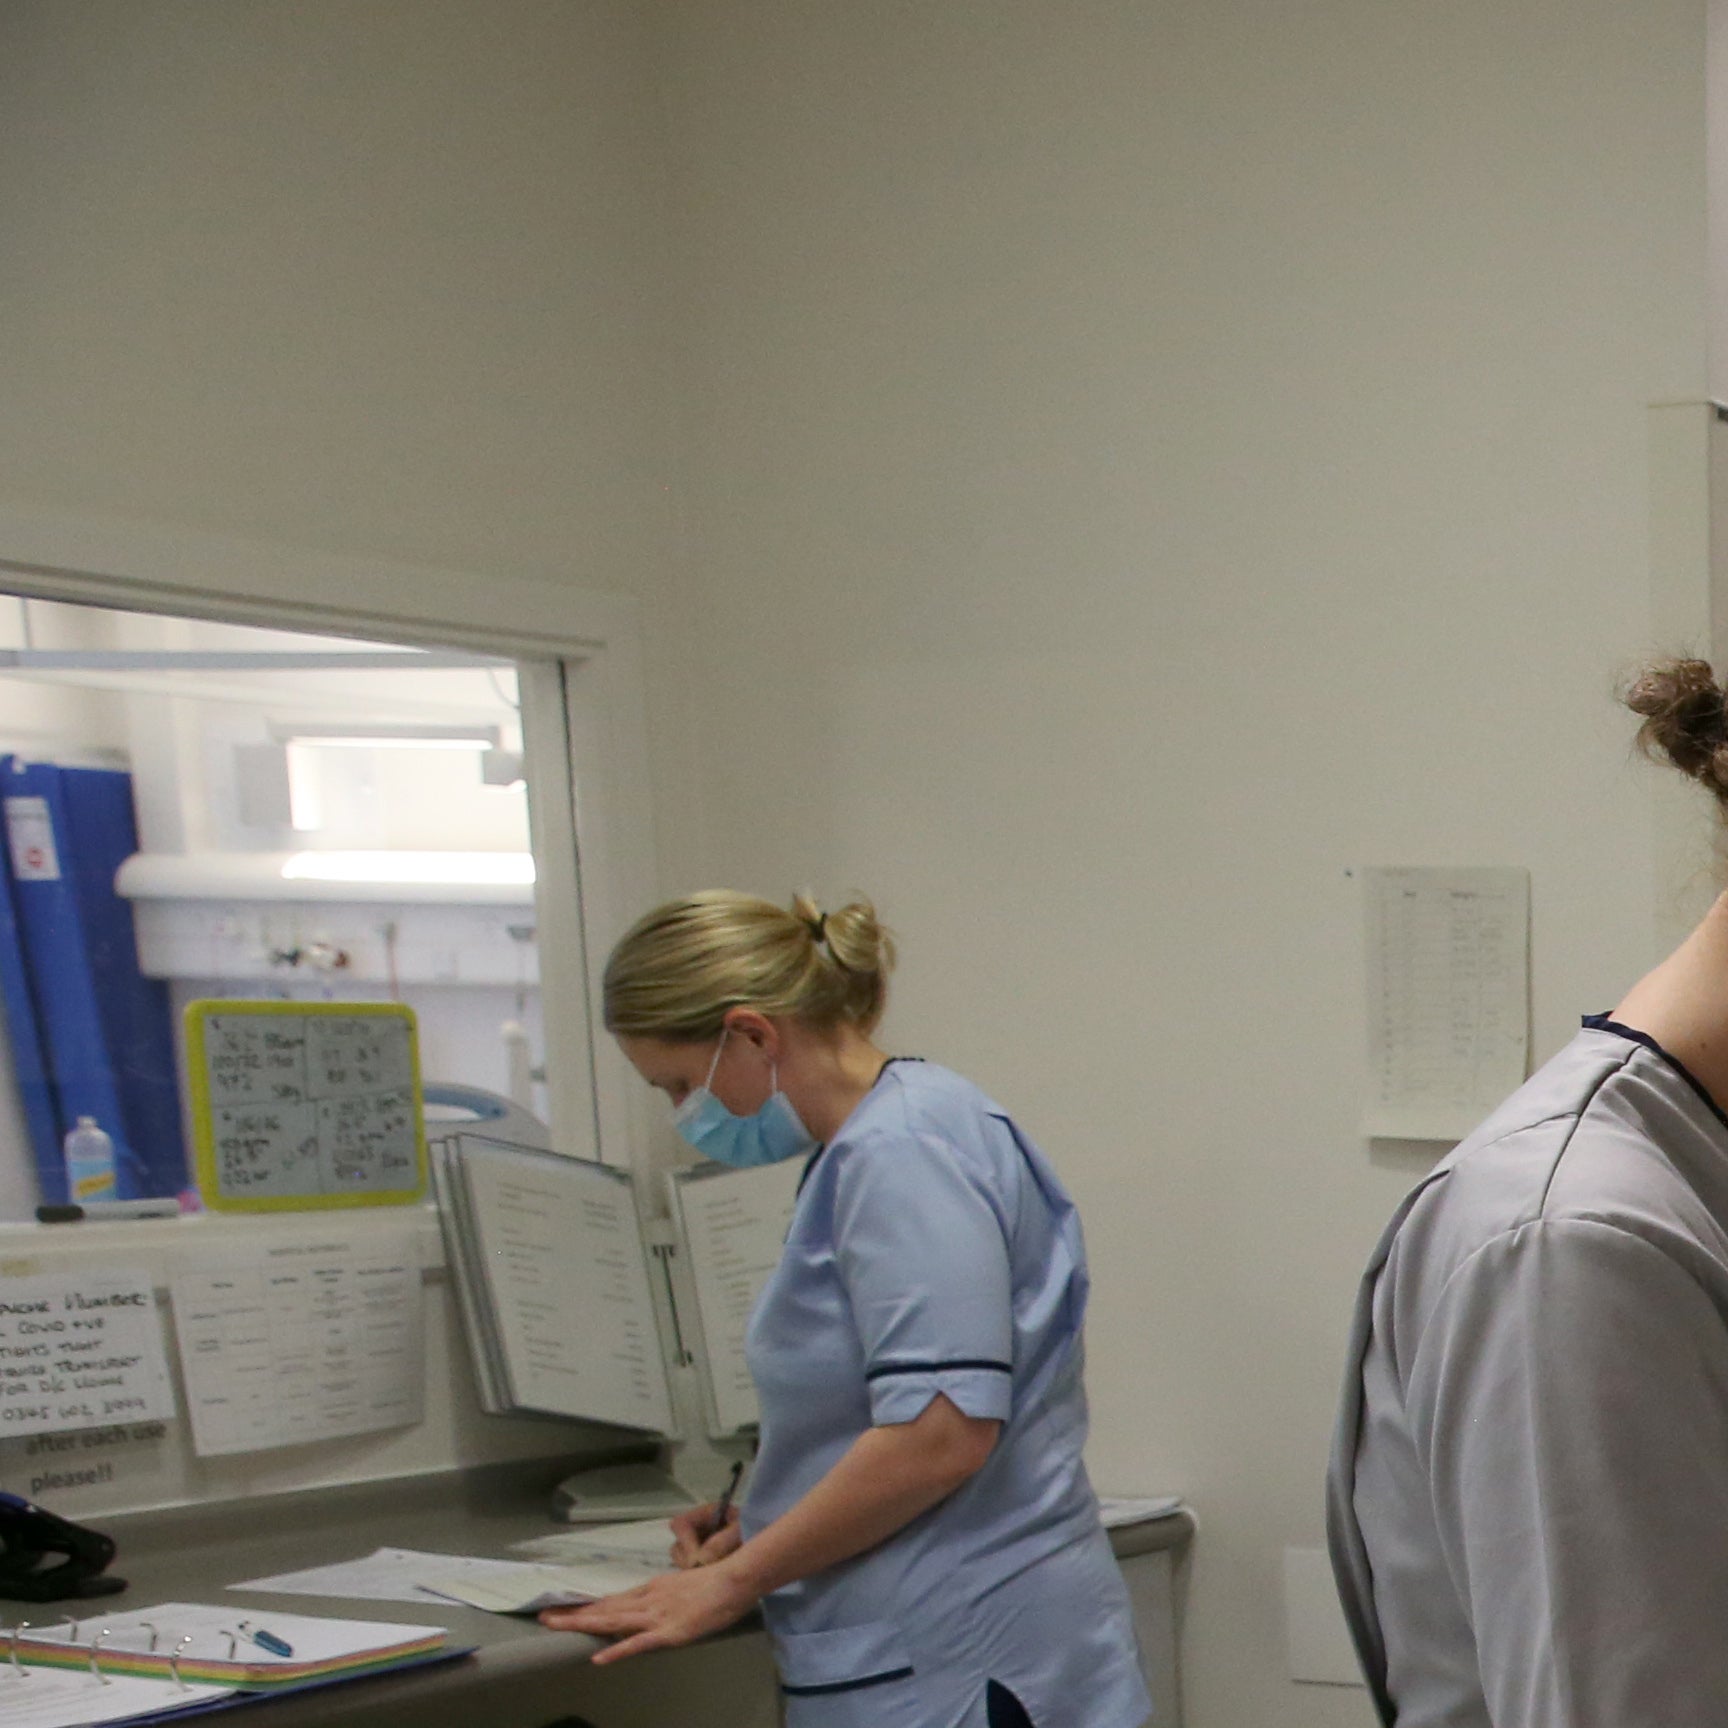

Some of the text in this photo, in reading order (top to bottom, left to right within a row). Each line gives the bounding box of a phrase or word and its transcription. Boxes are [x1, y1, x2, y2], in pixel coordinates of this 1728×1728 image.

[27, 1419, 166, 1455] after each use
